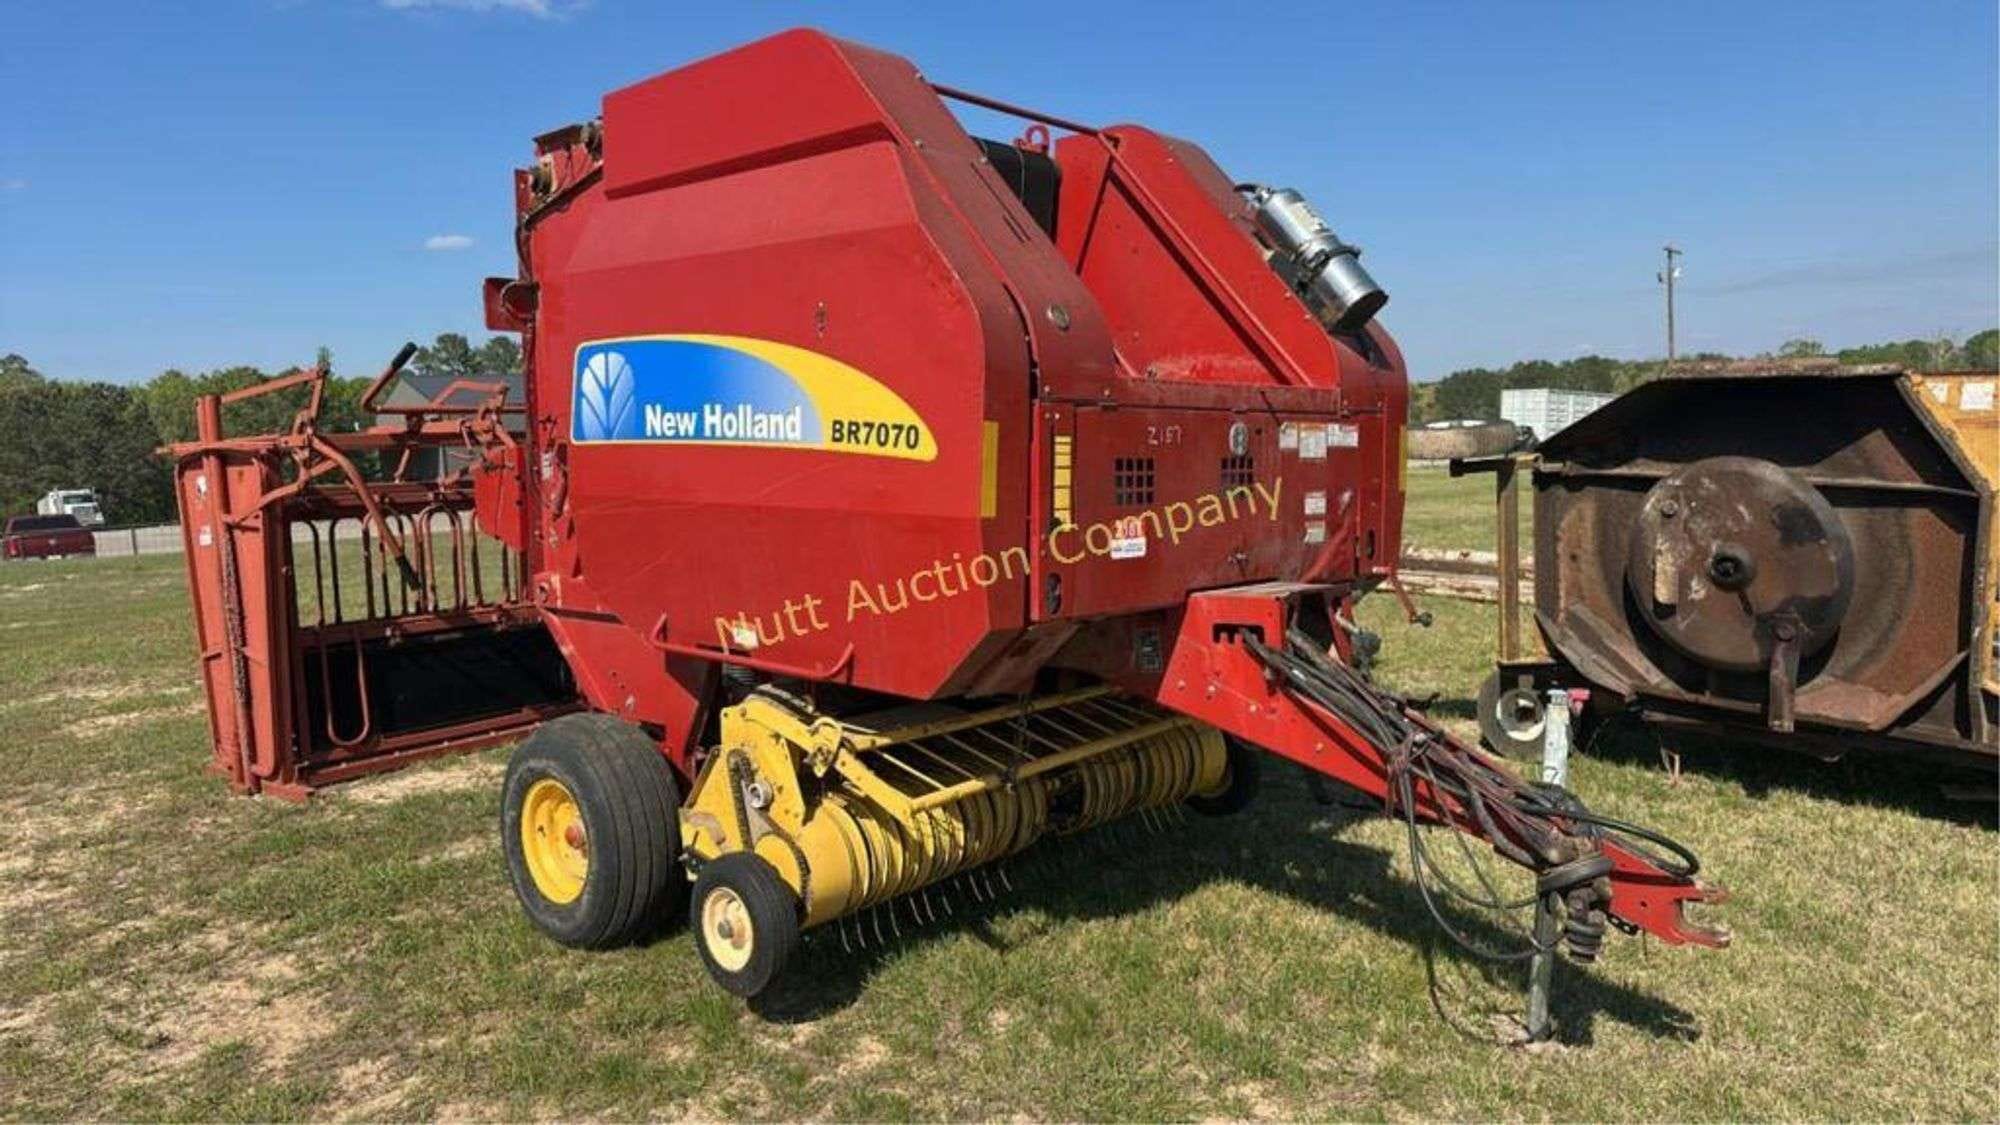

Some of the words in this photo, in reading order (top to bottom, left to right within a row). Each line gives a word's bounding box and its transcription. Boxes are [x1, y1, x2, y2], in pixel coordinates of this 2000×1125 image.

[644, 404, 698, 437] New
[703, 404, 801, 440] Holland
[831, 420, 920, 450] BR7070
